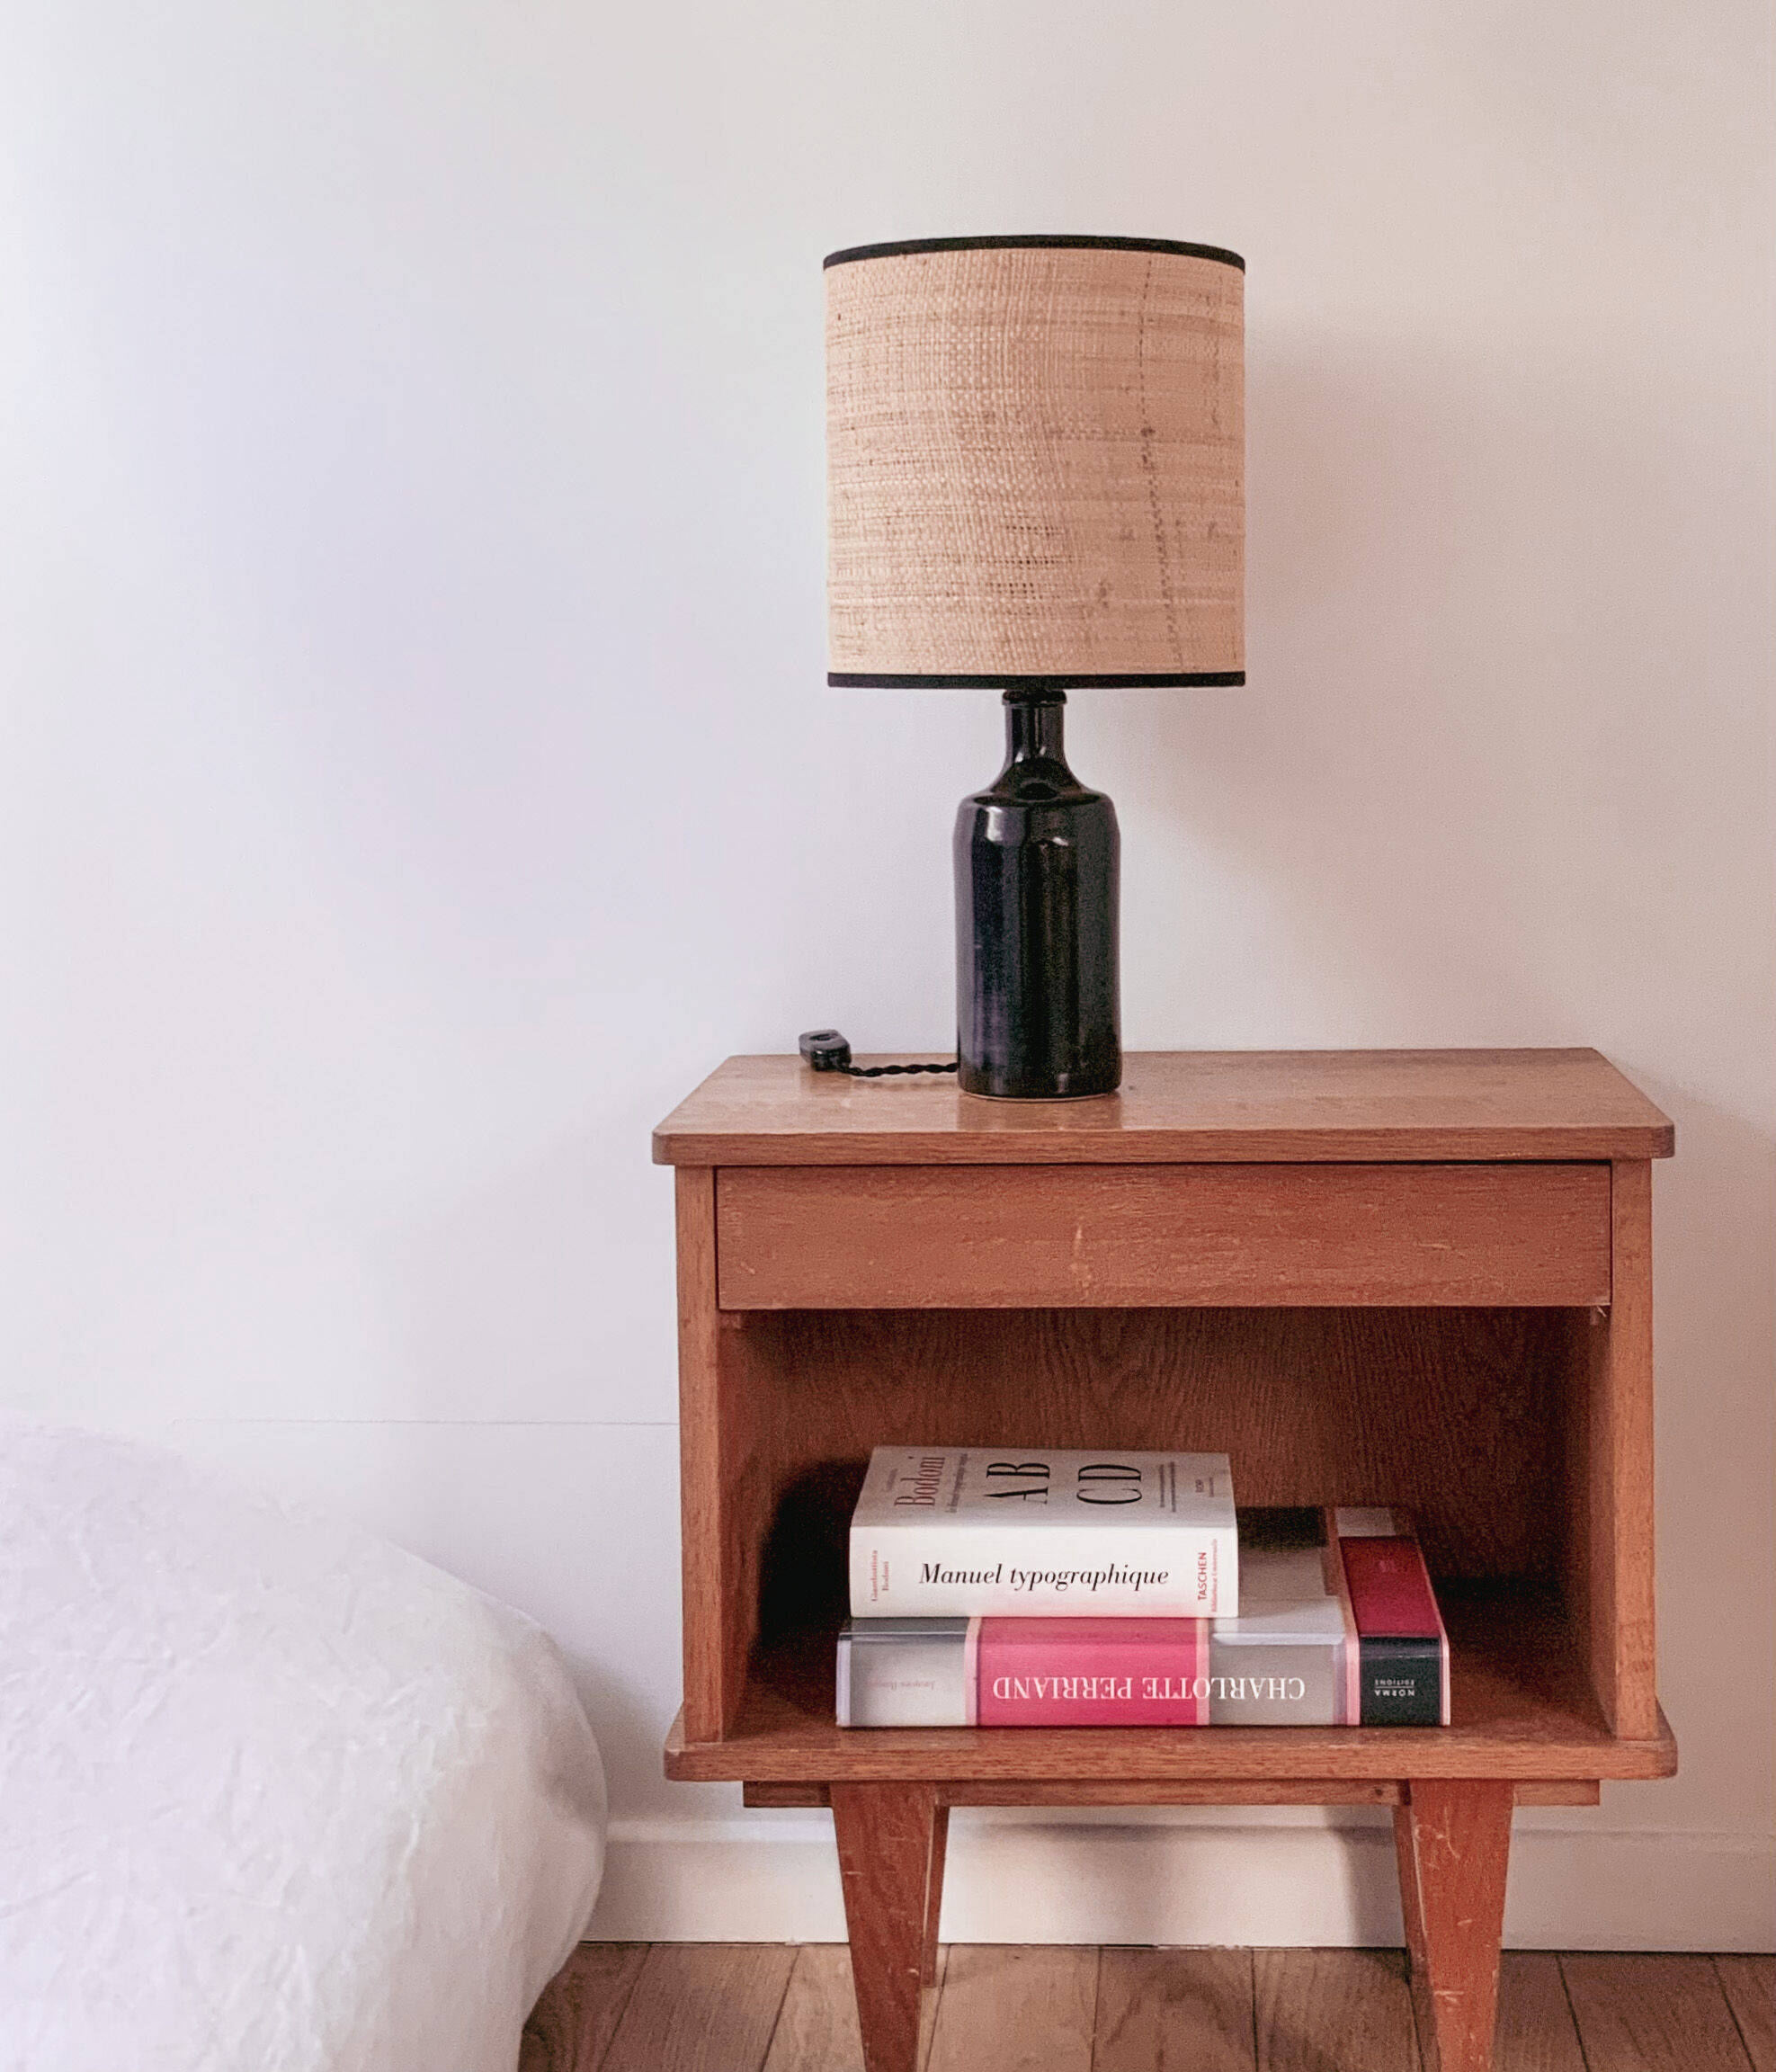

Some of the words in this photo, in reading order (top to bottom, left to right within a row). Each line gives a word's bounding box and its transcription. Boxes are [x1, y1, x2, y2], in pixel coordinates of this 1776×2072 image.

[894, 1456, 946, 1507] Bodoni
[919, 1563, 1003, 1585] Manuel
[1009, 1564, 1169, 1592] typographique
[1198, 1551, 1208, 1601] TASCHEN
[992, 1676, 1132, 1700] PERRIAND
[1142, 1676, 1306, 1700] CHARLOTTE
[1374, 1689, 1415, 1697] NORMA
